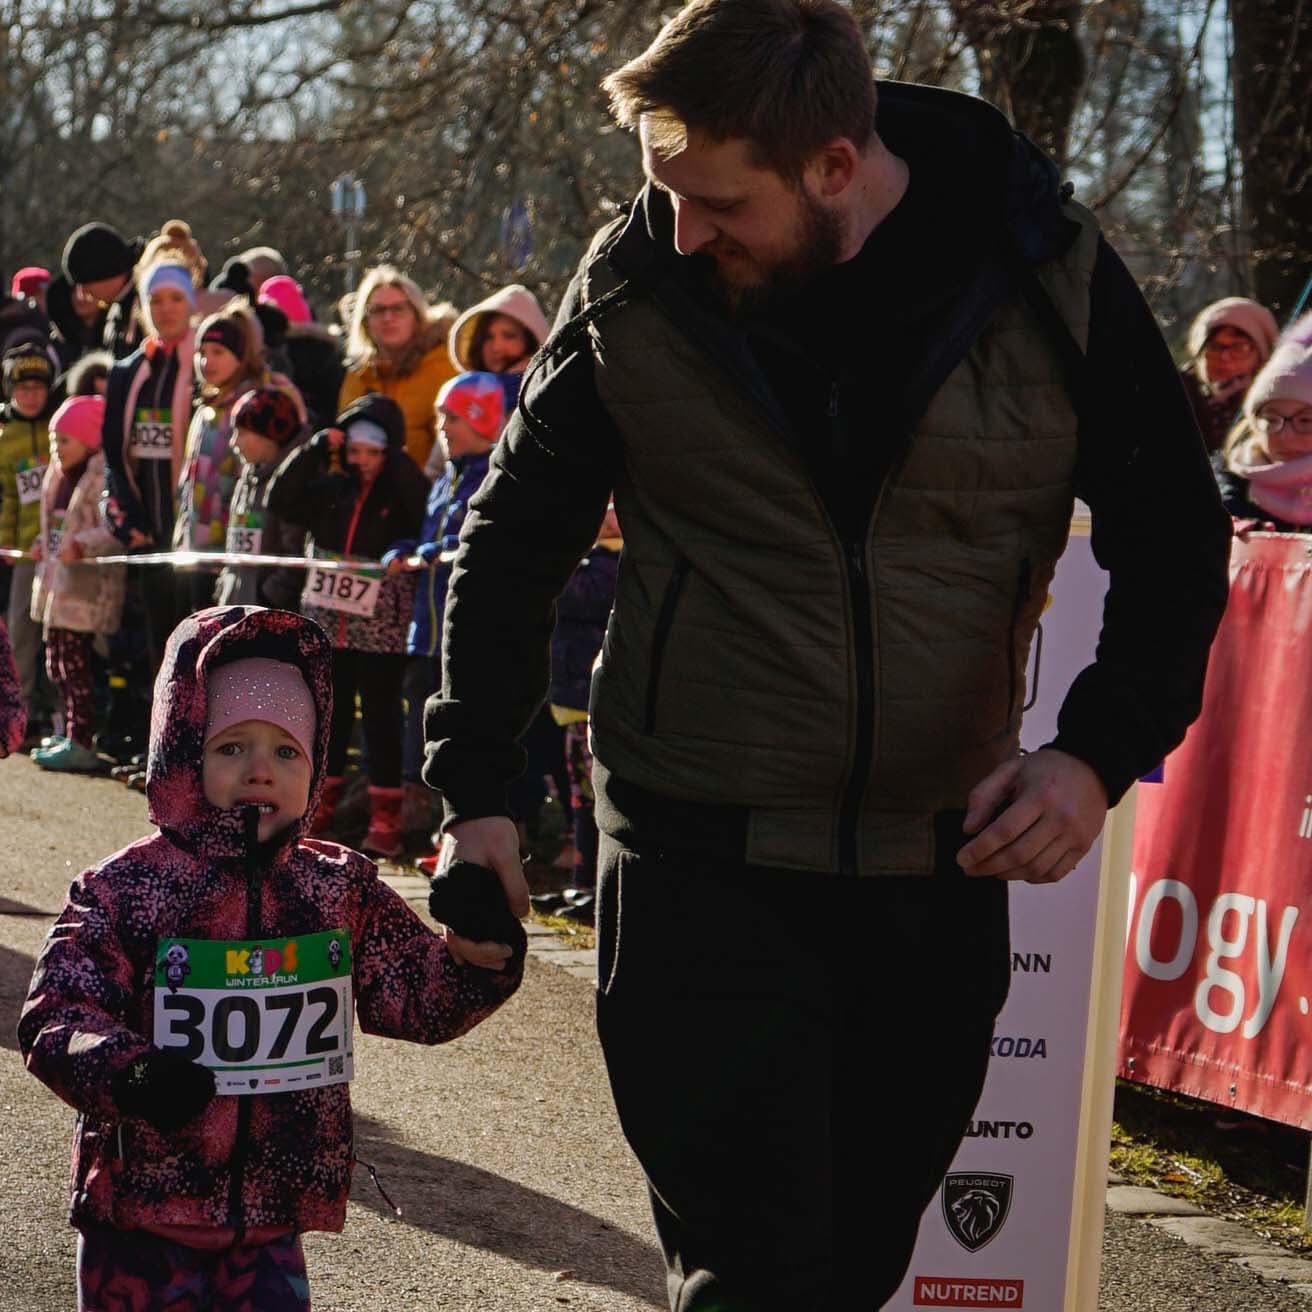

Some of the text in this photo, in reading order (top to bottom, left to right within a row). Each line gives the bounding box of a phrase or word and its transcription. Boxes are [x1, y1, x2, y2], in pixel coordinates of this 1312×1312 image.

[312, 569, 372, 601] 3187
[163, 987, 339, 1063] 3072
[949, 1179, 1007, 1189] PEUGEOT
[920, 1283, 1019, 1303] NUTREND
